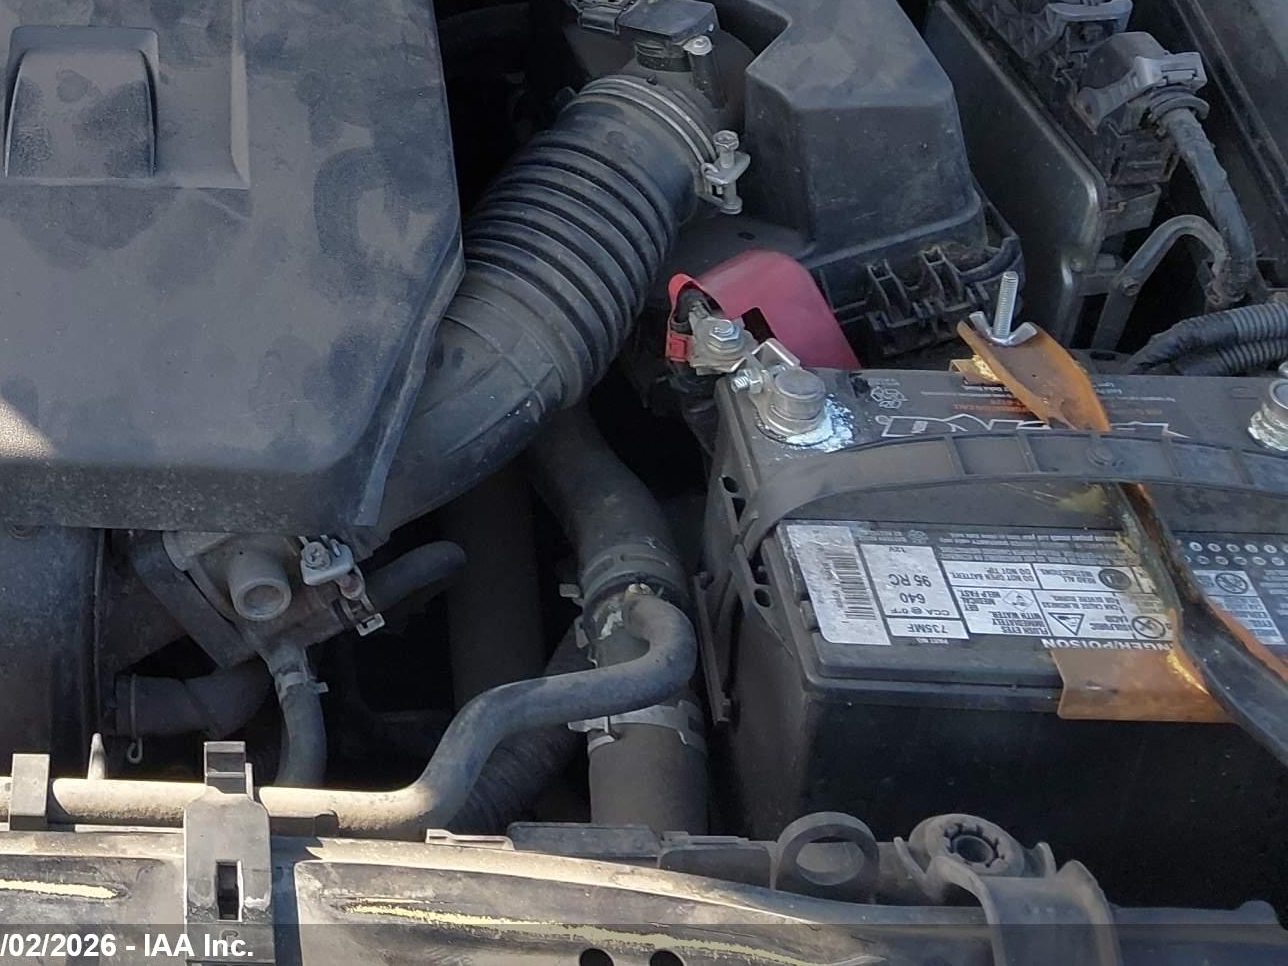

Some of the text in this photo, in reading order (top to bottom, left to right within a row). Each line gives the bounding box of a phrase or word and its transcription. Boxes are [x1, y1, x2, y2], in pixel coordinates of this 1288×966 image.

[888, 573, 932, 587] 95 RC
[899, 592, 926, 604] 640
[906, 623, 948, 634] 735MF
[1001, 626, 1022, 634] EYES
